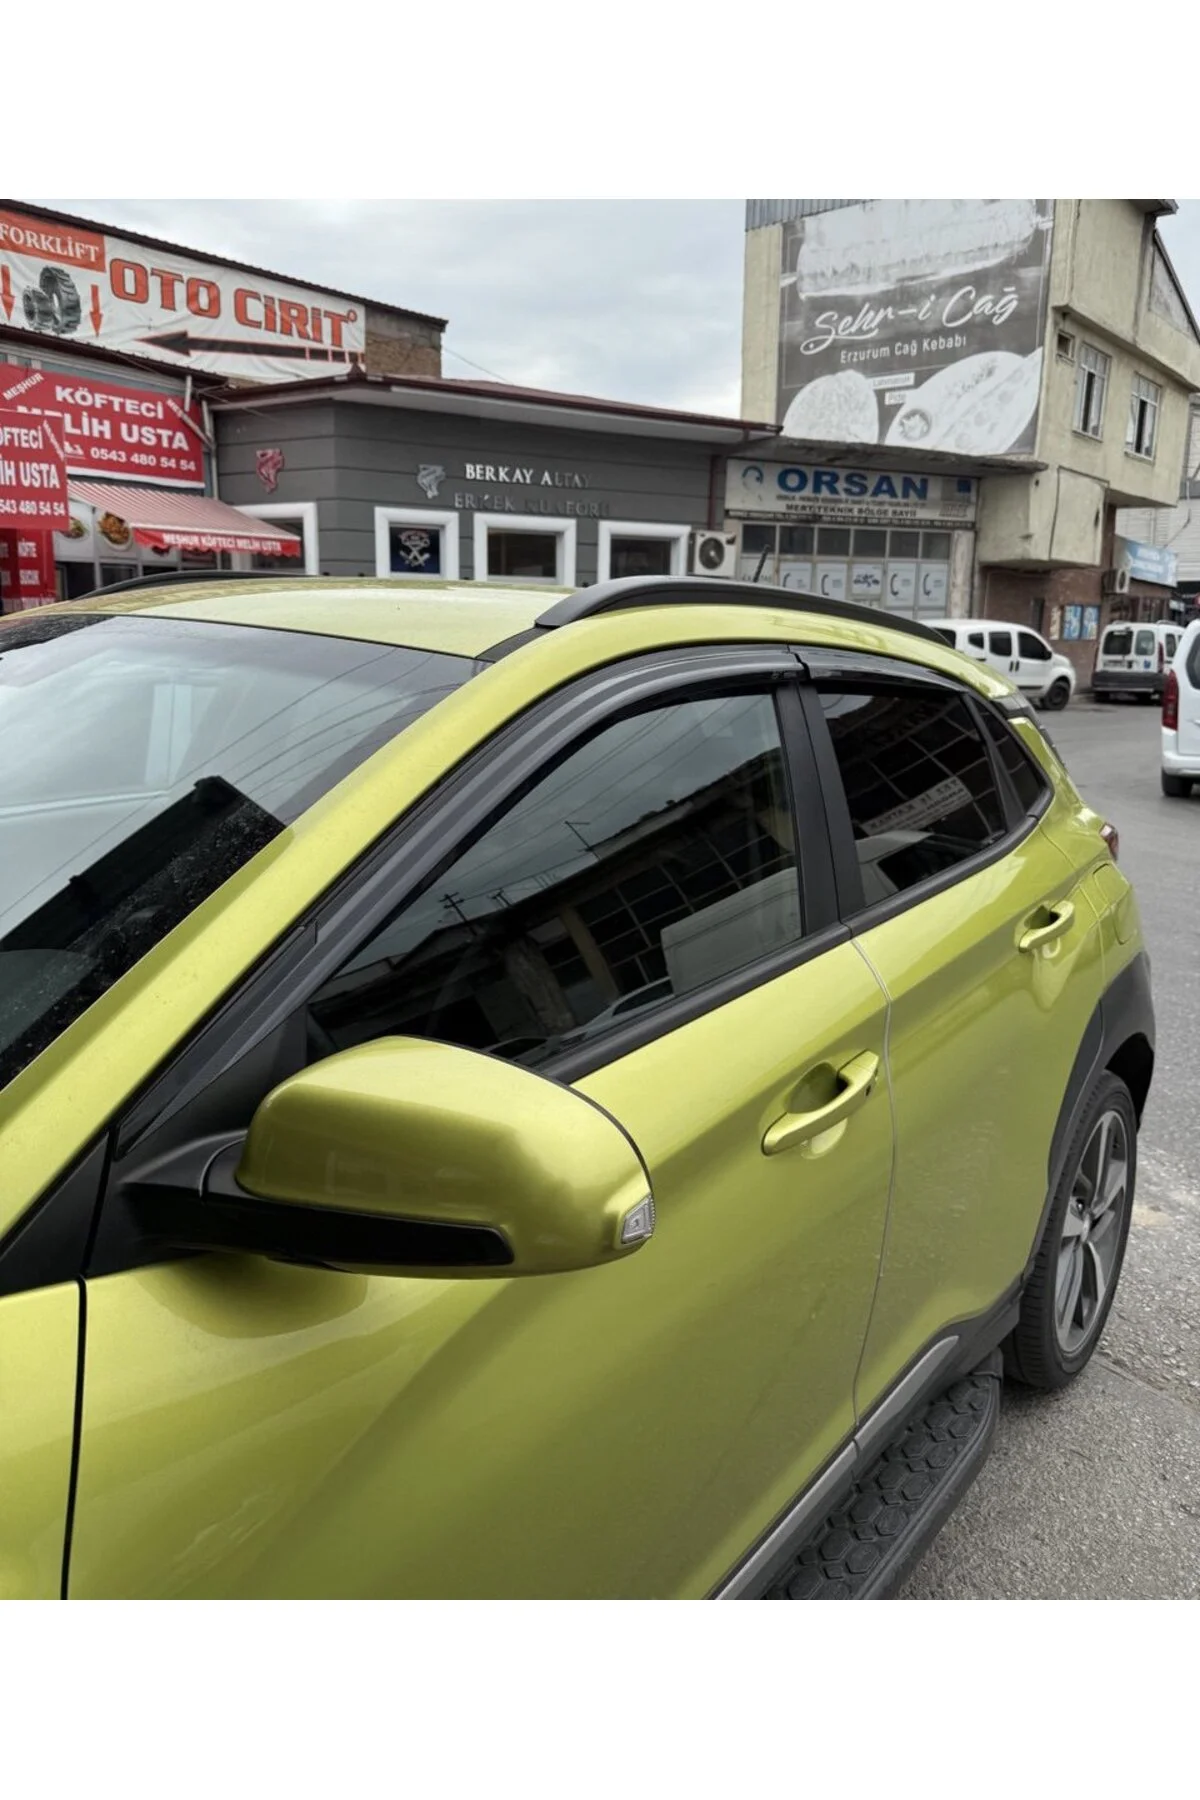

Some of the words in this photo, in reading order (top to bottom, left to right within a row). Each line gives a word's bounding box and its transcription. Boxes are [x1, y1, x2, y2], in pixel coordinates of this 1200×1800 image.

[0, 223, 100, 262] FORKLİFT
[109, 258, 222, 319] OTO
[234, 288, 349, 348] CİRİT
[841, 345, 890, 363] Erzurum
[55, 384, 164, 420] KÖFTECİ
[0, 425, 43, 450] FTECİ
[120, 422, 190, 451] USTA
[90, 446, 127, 463] 0543
[130, 451, 157, 466] 480
[159, 456, 177, 469] 54
[180, 458, 197, 472] 54
[19, 461, 60, 489] USTA
[465, 463, 534, 485] BERKAY
[540, 470, 592, 489] ALTAY
[777, 467, 928, 501] ORSAN
[19, 499, 37, 515] 480
[39, 501, 51, 516] 54
[53, 501, 66, 517] 54
